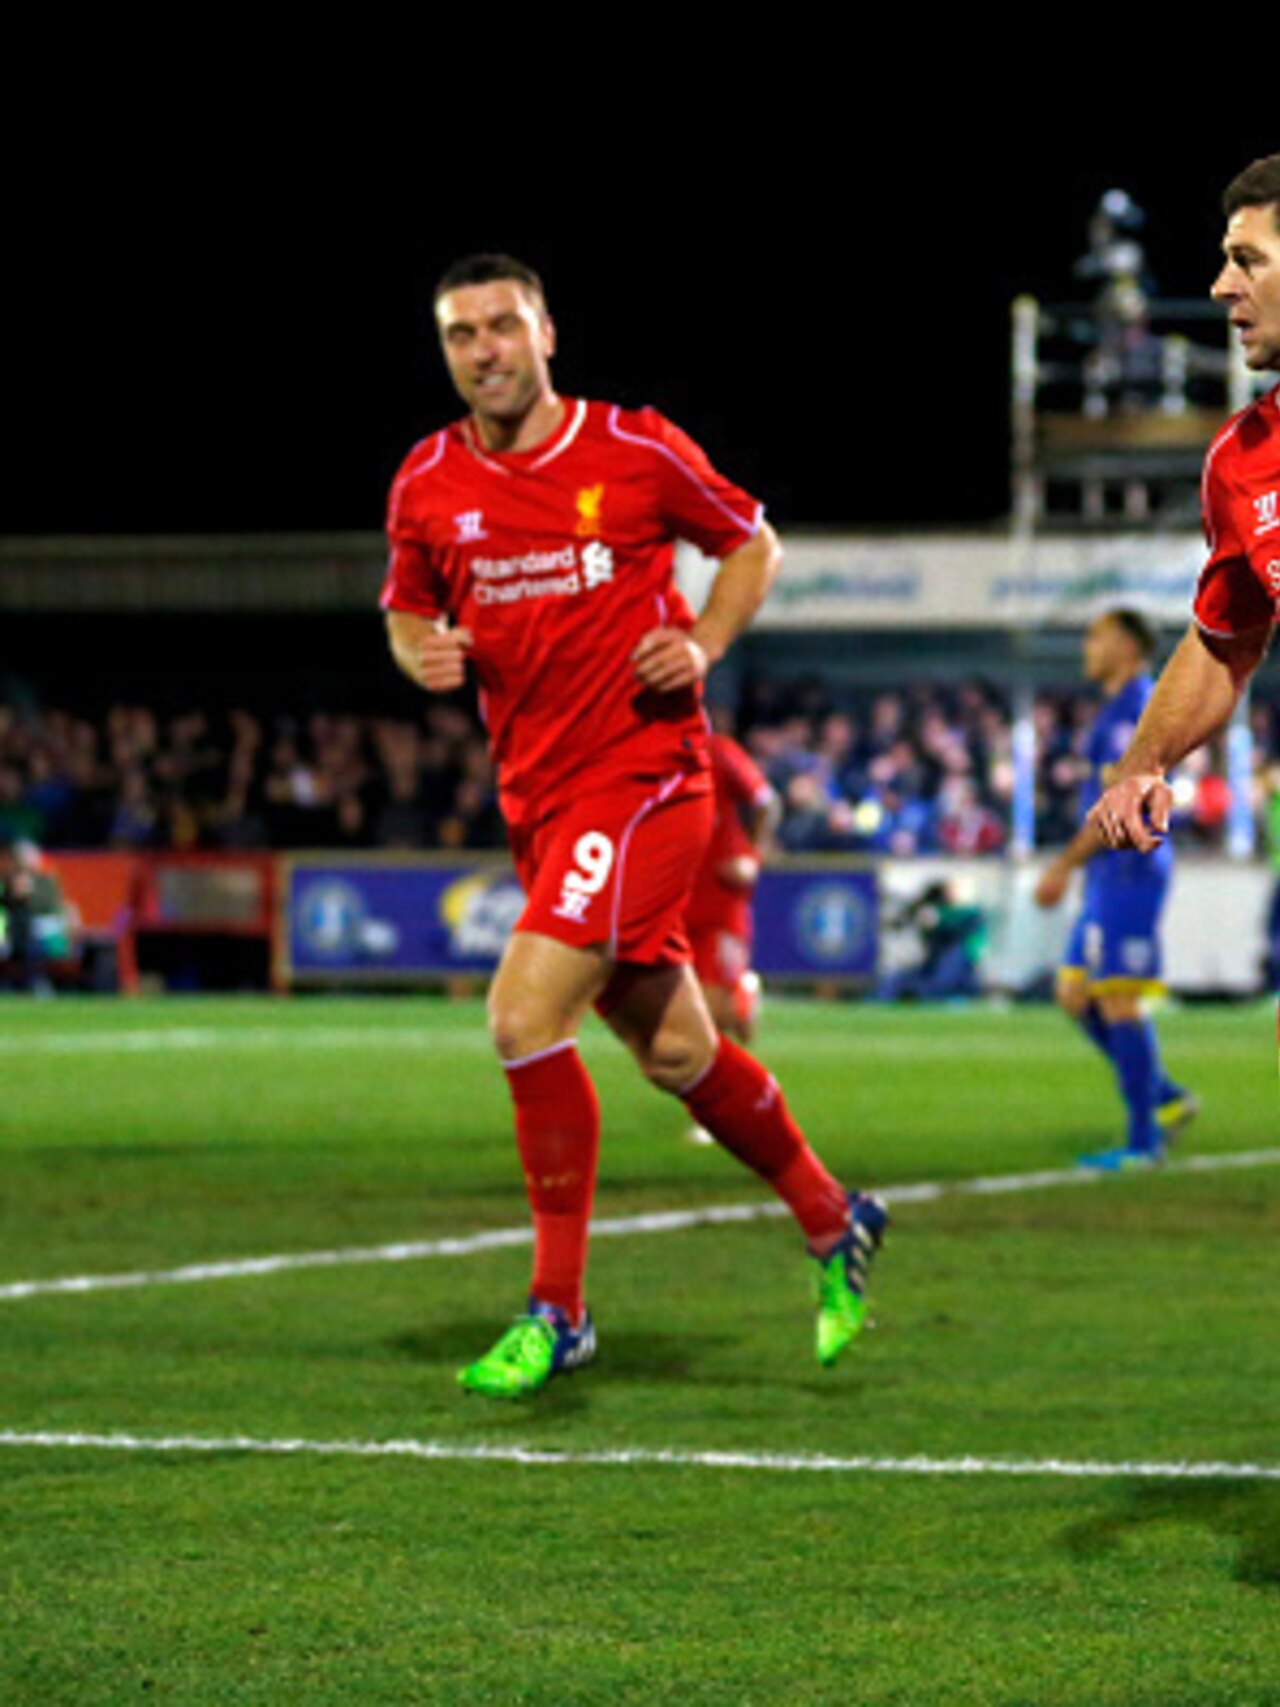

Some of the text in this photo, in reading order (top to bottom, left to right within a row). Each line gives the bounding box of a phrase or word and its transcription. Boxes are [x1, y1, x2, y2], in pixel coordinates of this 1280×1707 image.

[470, 543, 576, 579] Standard
[472, 571, 581, 606] Chartered
[564, 830, 615, 894] 9
